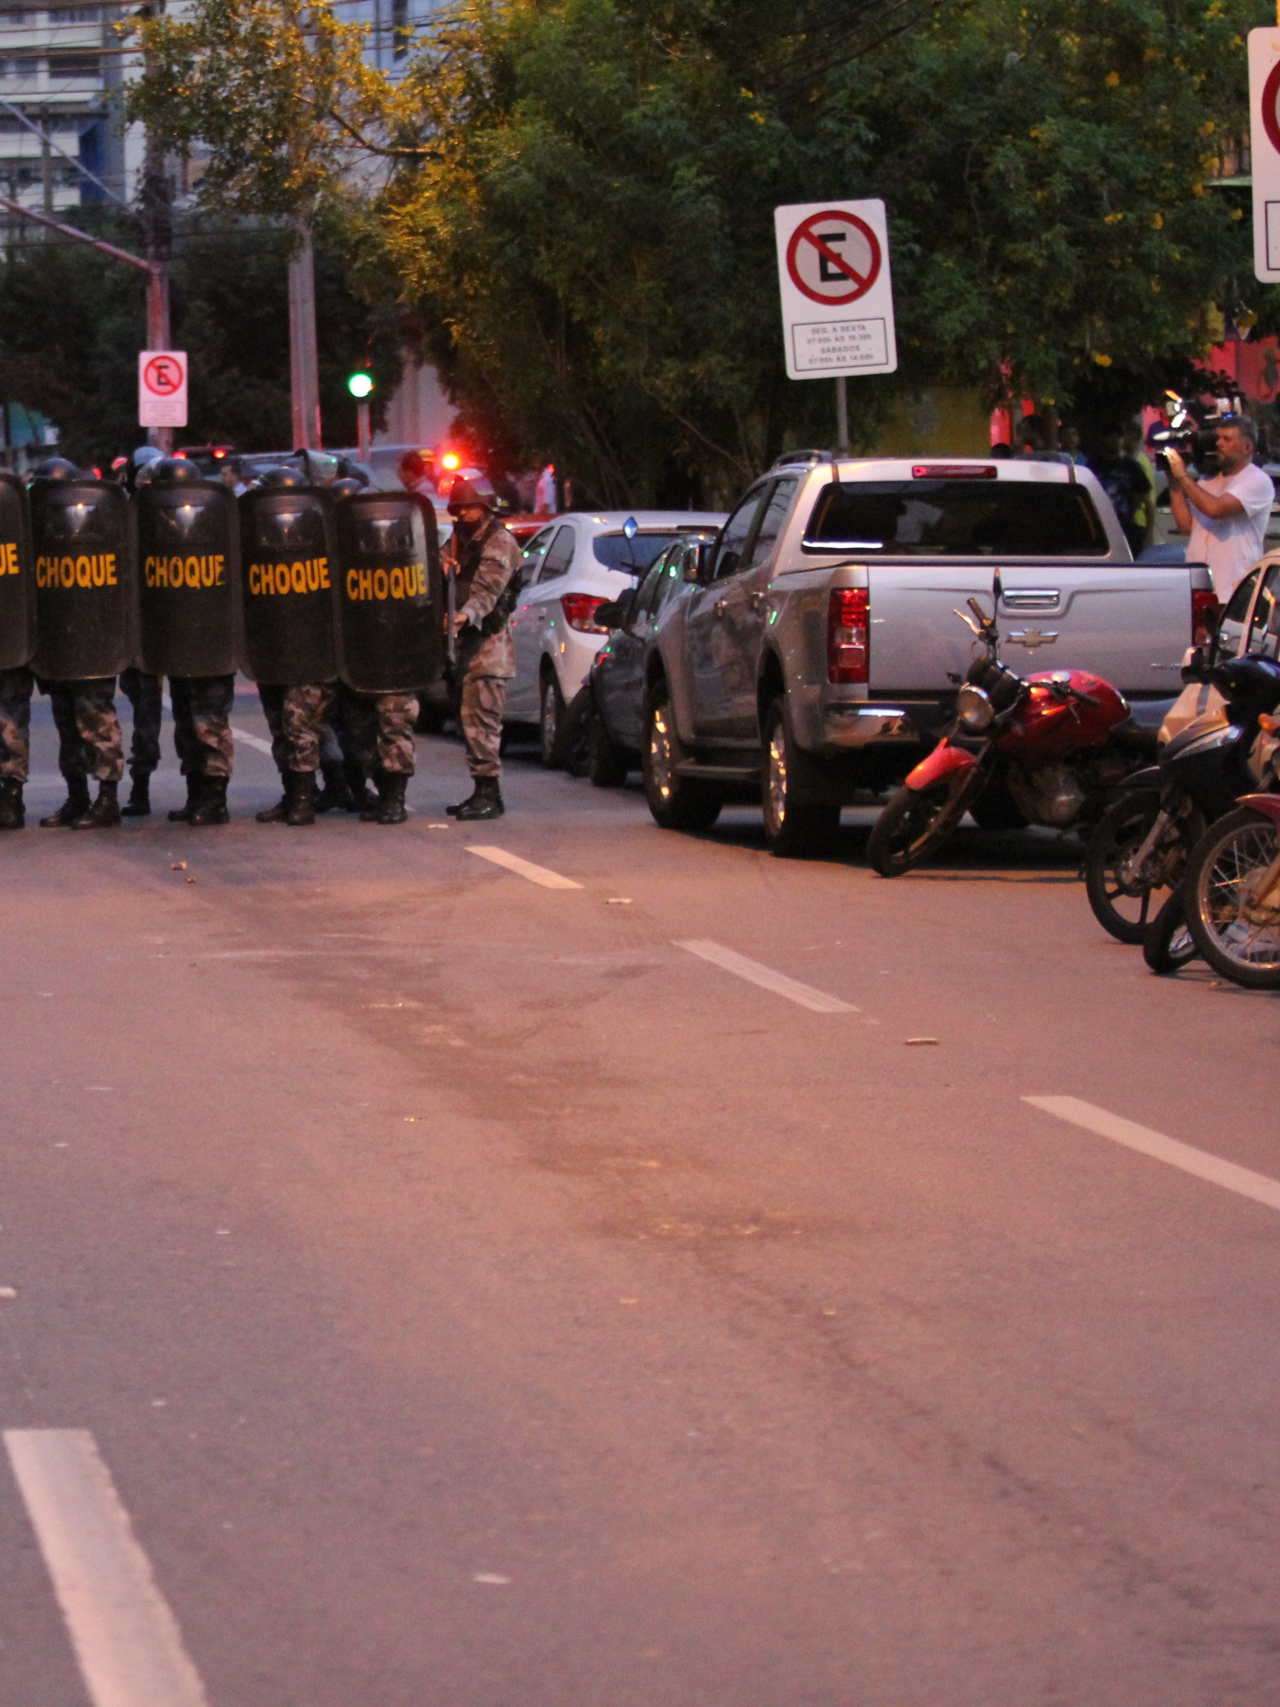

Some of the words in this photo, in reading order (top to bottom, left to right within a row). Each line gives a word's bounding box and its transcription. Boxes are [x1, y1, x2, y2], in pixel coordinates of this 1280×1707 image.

[840, 325, 866, 333] SEXTA
[36, 554, 118, 589] CHOQUE
[145, 555, 225, 589] CHOQUE
[249, 557, 332, 595] CHOQUE
[346, 563, 428, 601] CHOQUE
